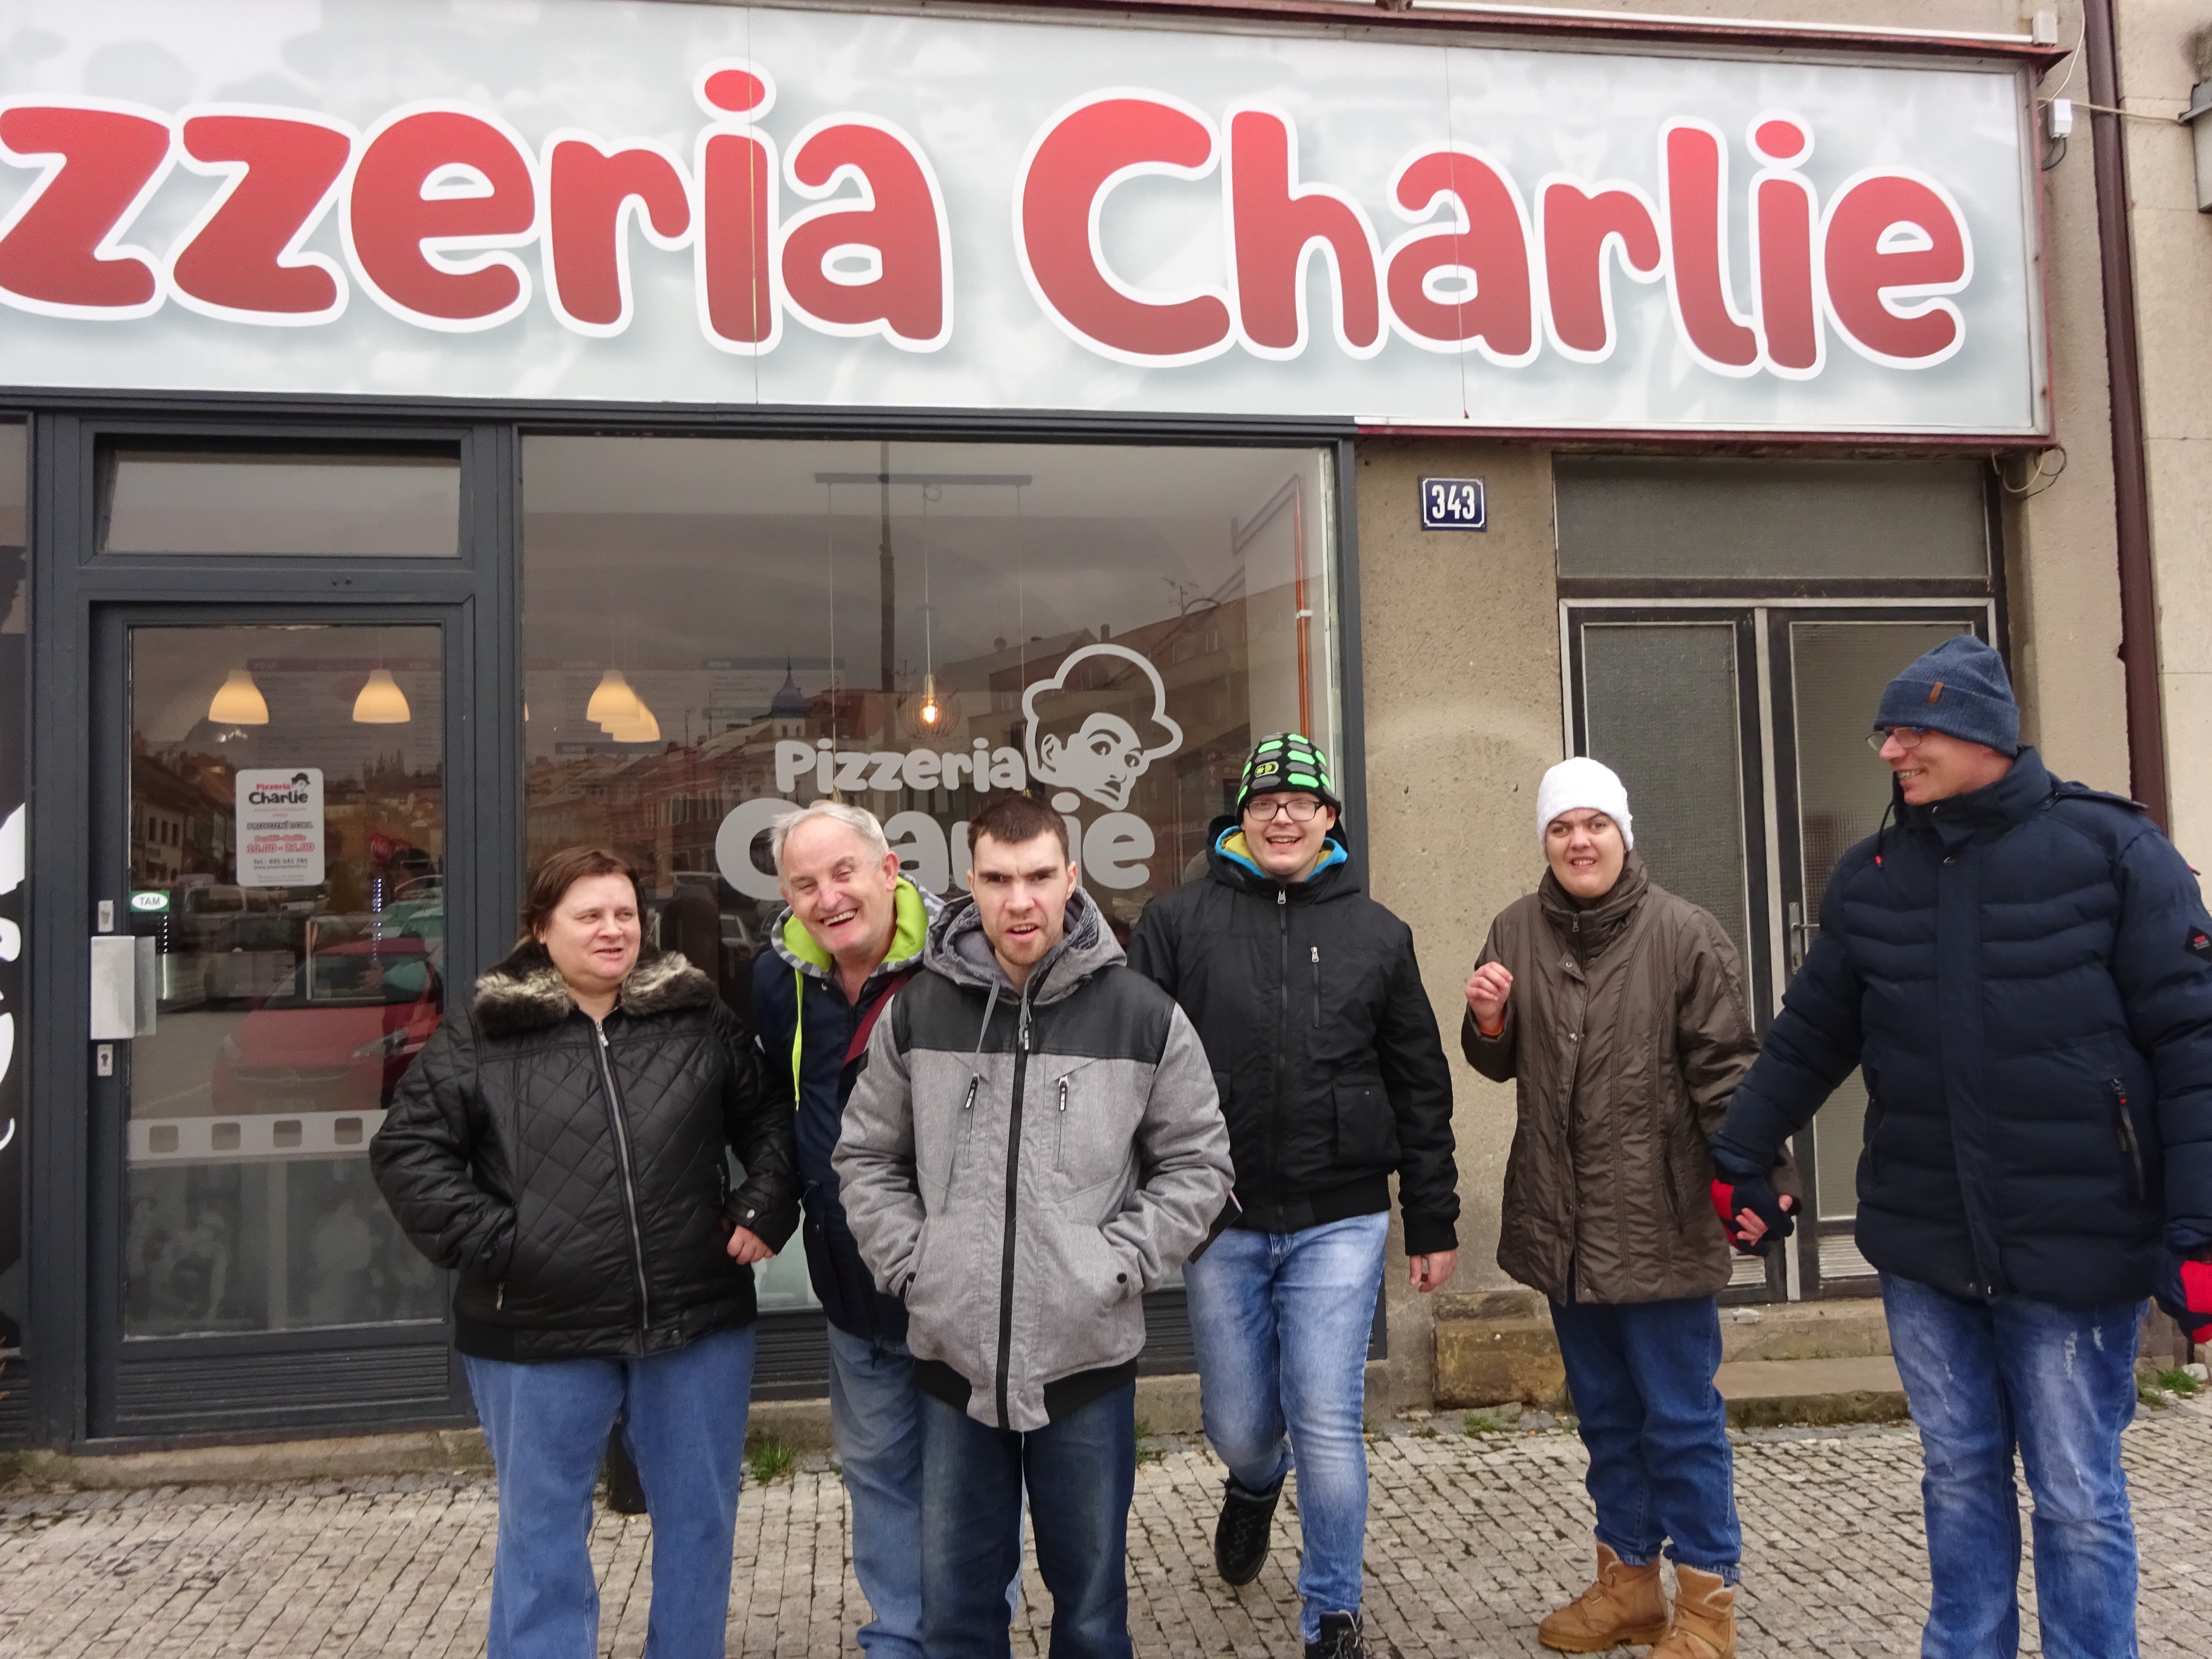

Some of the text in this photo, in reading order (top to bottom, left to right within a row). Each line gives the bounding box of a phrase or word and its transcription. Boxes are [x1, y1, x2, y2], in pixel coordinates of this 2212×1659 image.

[1021, 97, 1966, 370] Charlie
[1431, 484, 1475, 520] 343
[775, 737, 1026, 794] Pizzeria
[248, 791, 309, 804] Charlie
[139, 896, 160, 906] TAM
